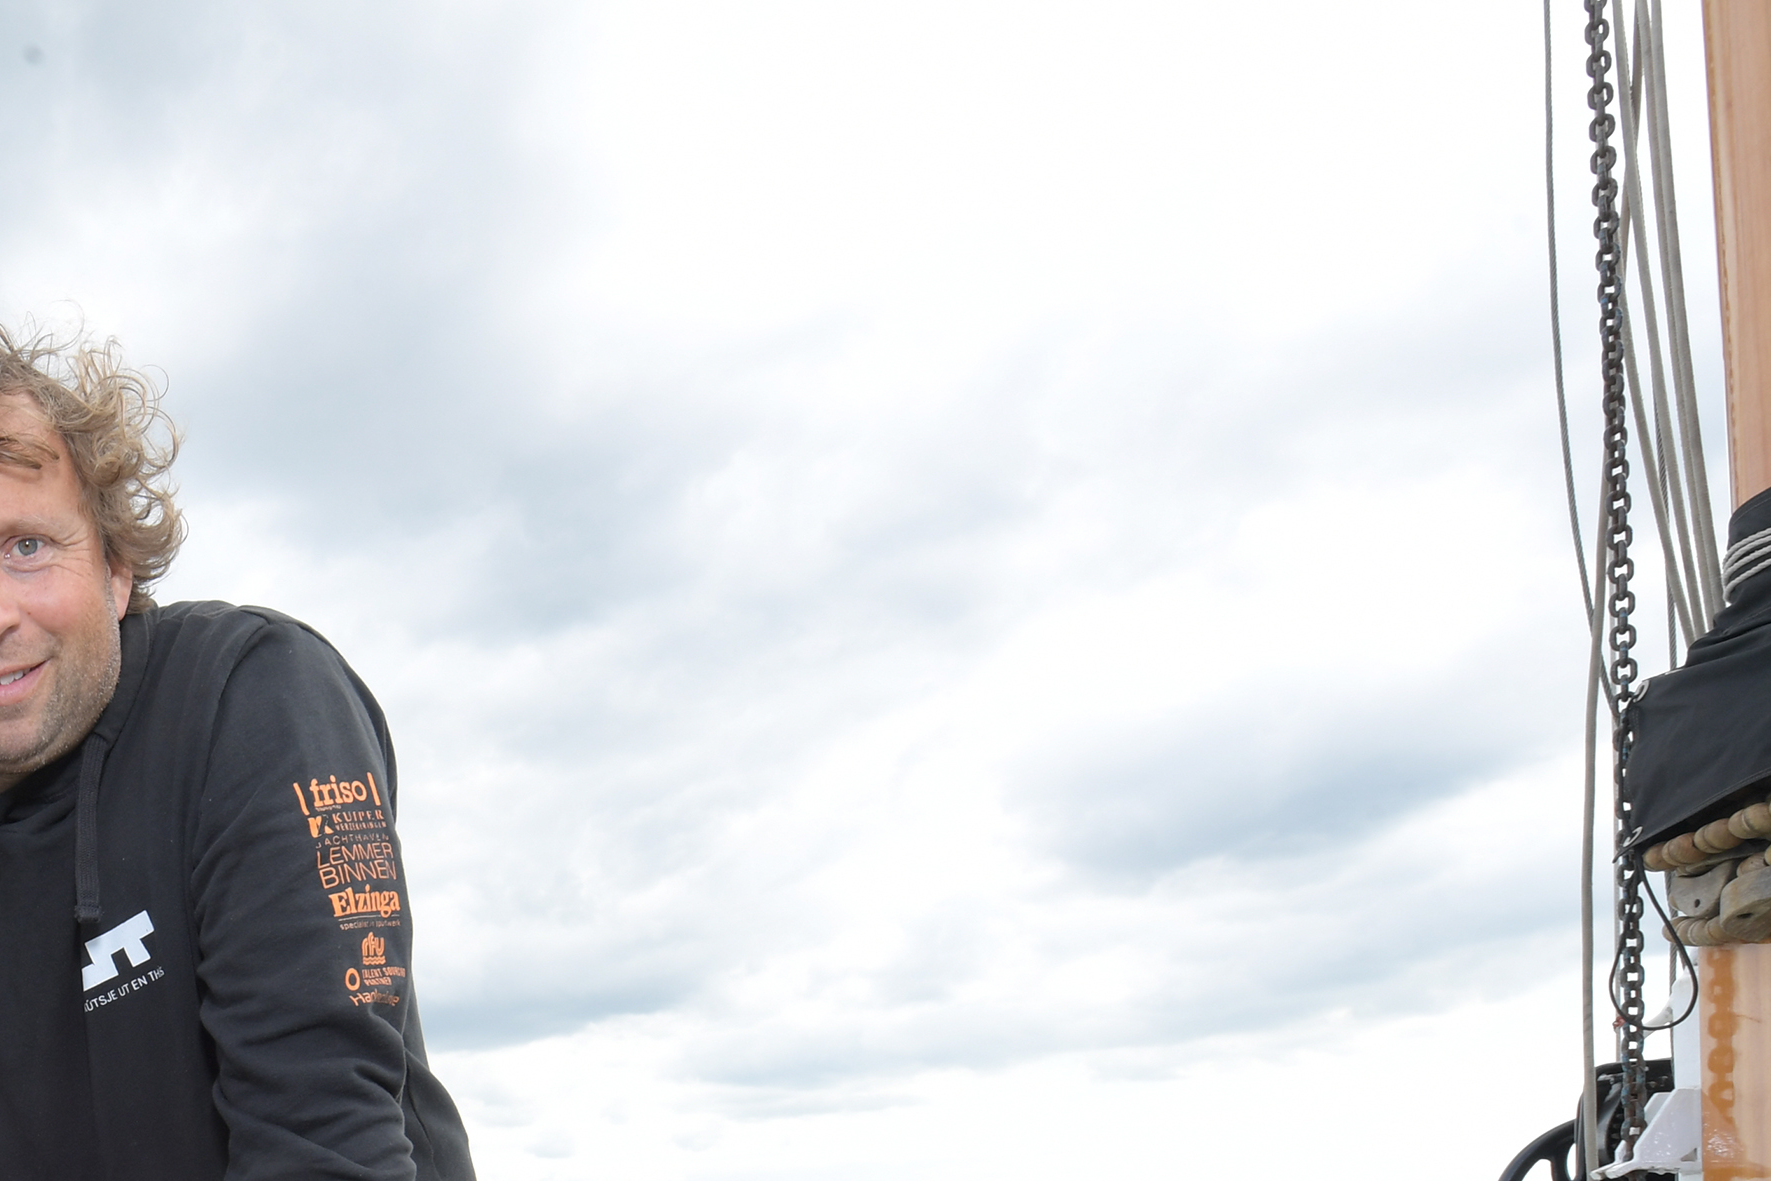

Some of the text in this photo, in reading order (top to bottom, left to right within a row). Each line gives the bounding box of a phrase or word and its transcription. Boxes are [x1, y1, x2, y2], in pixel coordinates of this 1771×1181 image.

[309, 775, 367, 807] friso
[332, 809, 384, 823] KUIPER
[316, 834, 389, 848] JACHTHAVEN
[317, 842, 393, 869] LEMMER
[319, 860, 396, 889] BINNEN
[328, 883, 401, 918] Elzinga
[118, 983, 130, 996] UT
[131, 976, 148, 990] EN
